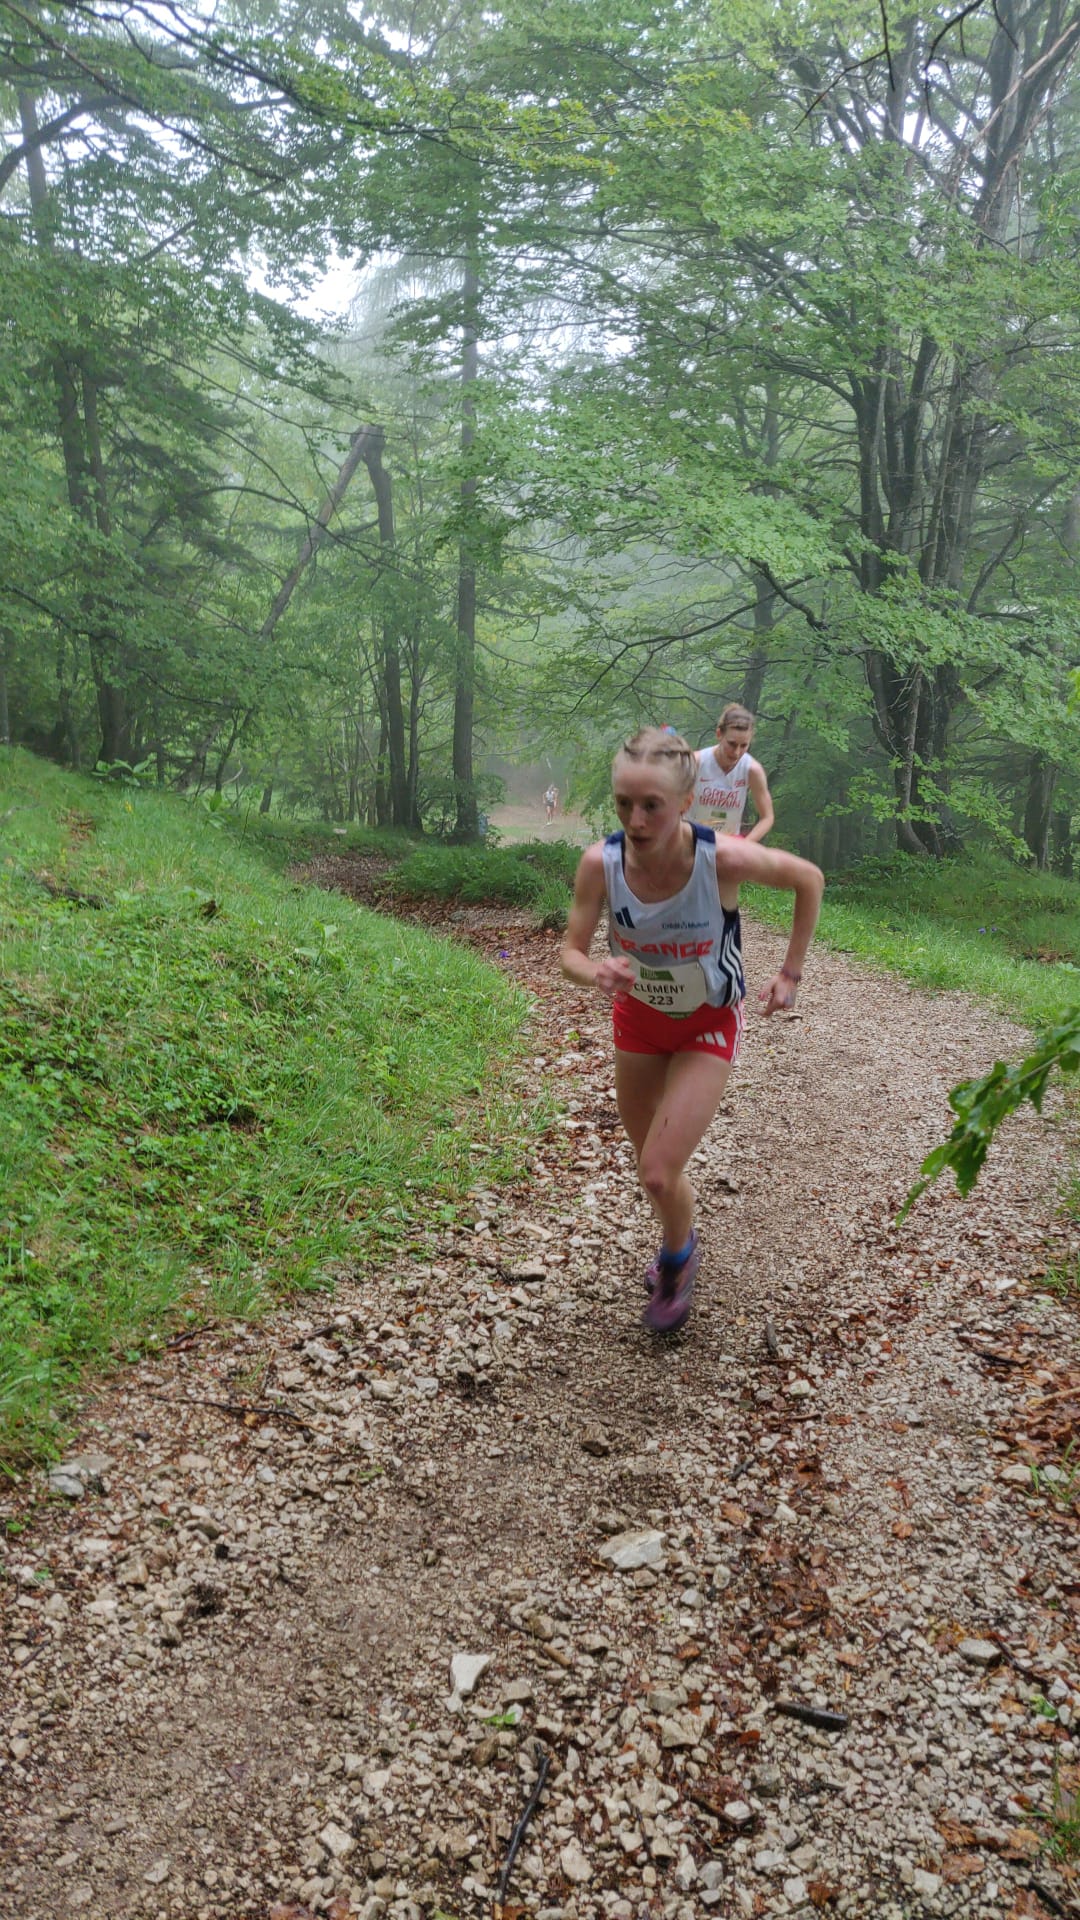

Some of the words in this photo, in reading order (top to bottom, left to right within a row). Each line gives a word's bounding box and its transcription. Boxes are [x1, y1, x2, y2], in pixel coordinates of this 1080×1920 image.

[703, 787, 739, 800] GREAT
[699, 796, 740, 808] BRITAIN
[648, 995, 674, 1006] 223
